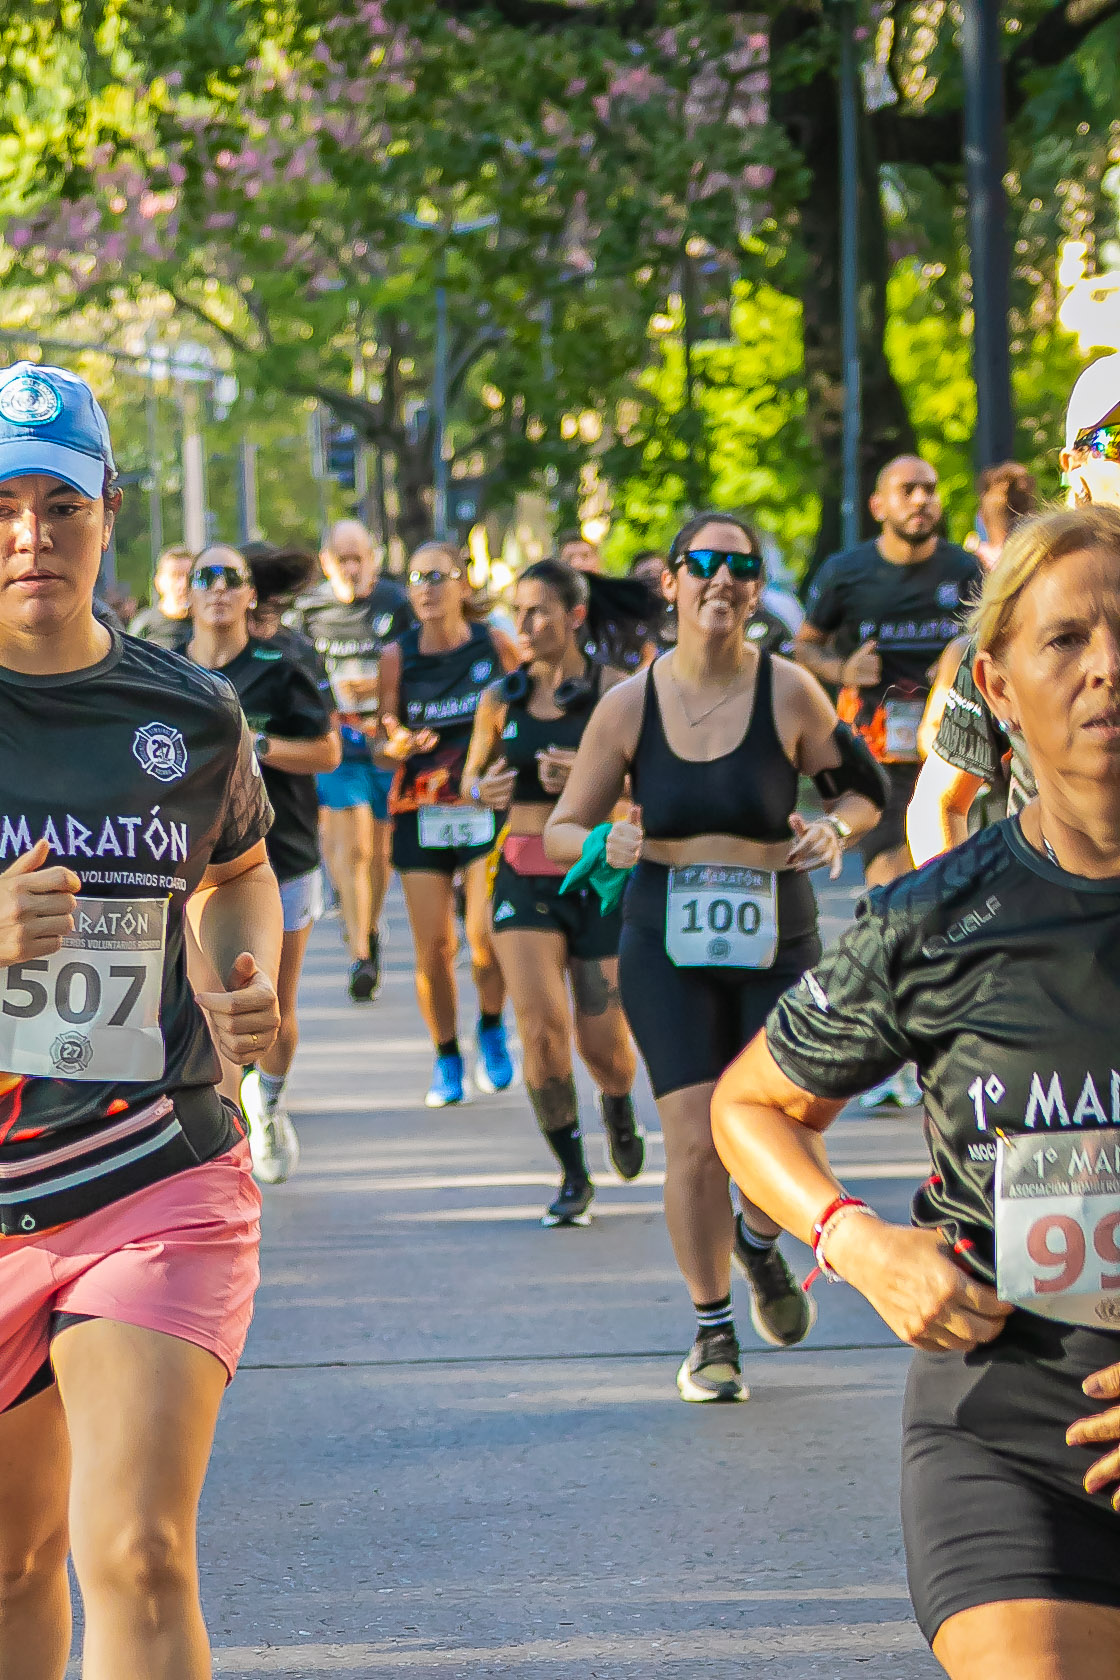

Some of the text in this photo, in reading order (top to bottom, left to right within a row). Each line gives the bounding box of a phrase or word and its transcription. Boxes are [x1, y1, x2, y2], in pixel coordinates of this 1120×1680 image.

[151, 739, 171, 760] 27
[80, 870, 158, 887] VOLUNTARIOS
[72, 906, 149, 935] RATÓN
[681, 899, 761, 936] 100
[2, 959, 147, 1027] 507
[63, 1043, 81, 1058] 27
